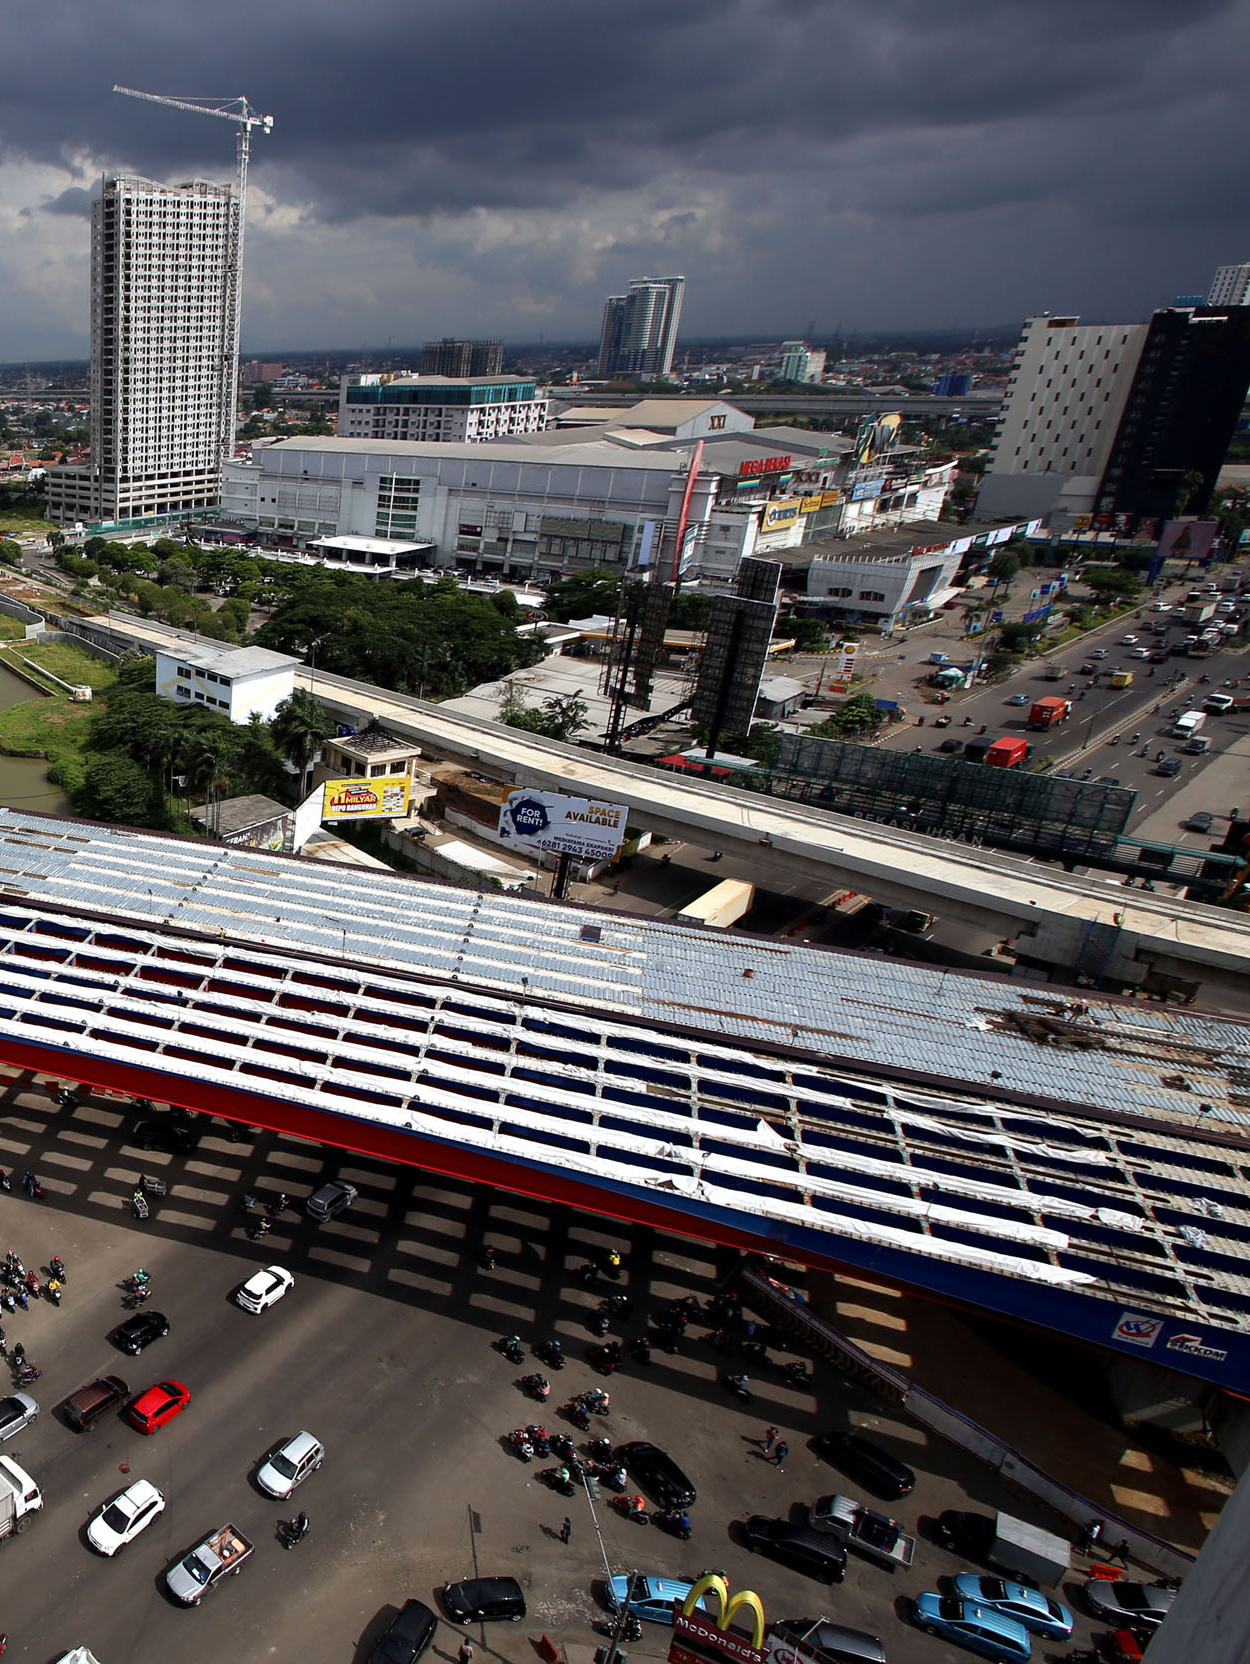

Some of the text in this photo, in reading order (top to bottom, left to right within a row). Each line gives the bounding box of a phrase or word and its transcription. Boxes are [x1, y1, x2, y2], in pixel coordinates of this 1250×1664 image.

[708, 415, 727, 430] XXI
[345, 795, 377, 804] MILYAR
[521, 807, 541, 817] FOR
[588, 805, 621, 819] SPACE
[516, 814, 543, 826] RENT!
[565, 811, 619, 828] AVAILABLE
[853, 811, 917, 832] BEKASI
[676, 1617, 762, 1663] McDonald's
